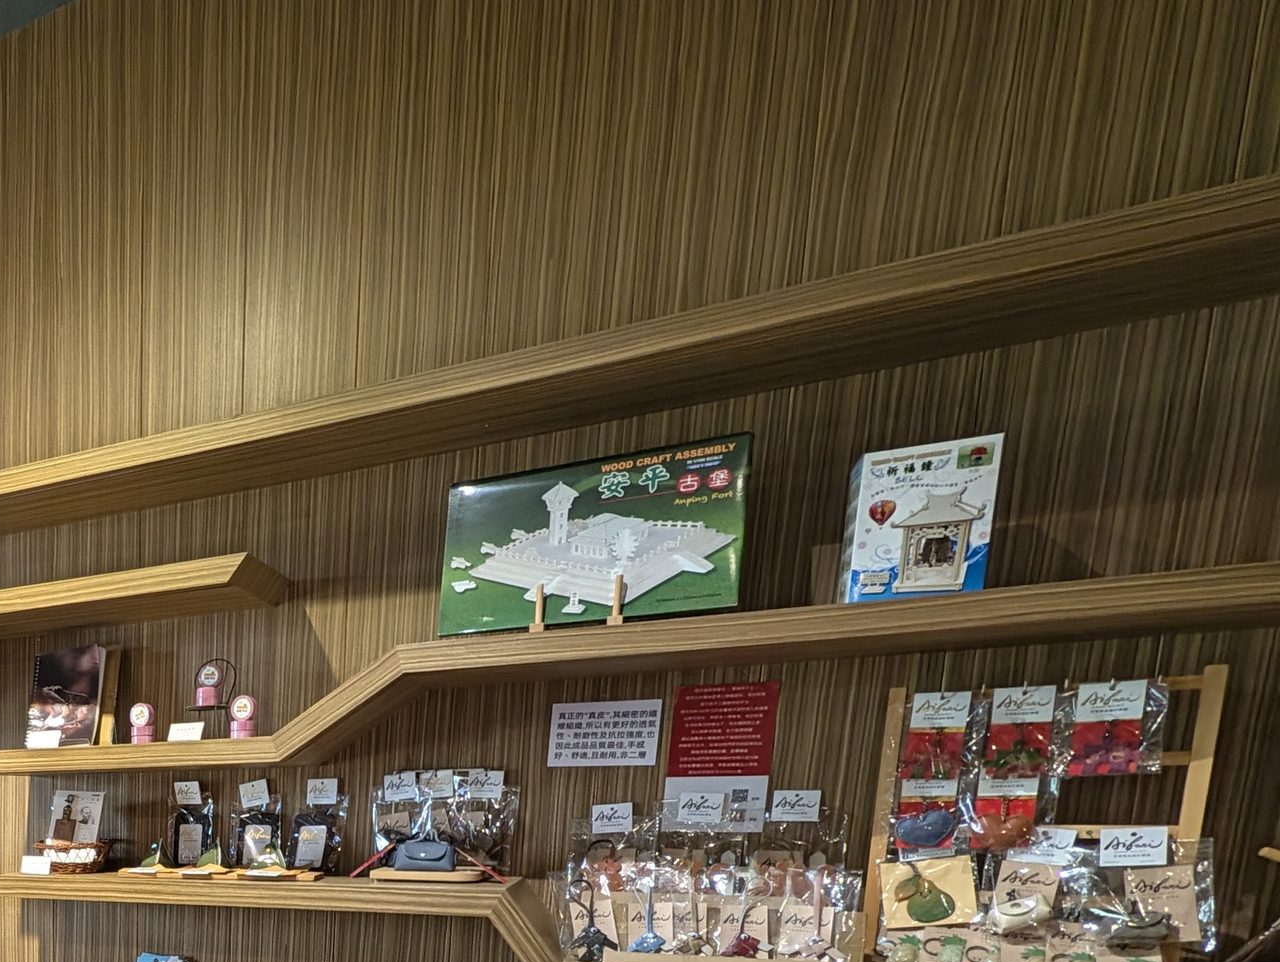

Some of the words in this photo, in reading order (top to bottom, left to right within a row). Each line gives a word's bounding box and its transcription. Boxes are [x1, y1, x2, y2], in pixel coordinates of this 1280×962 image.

[601, 461, 633, 473] WOOD
[636, 453, 672, 466] CRAFT
[675, 443, 737, 461] ASSEMBLY
[598, 464, 730, 499] 安平古堡
[673, 495, 708, 507] Anping
[712, 491, 733, 500] Fort
